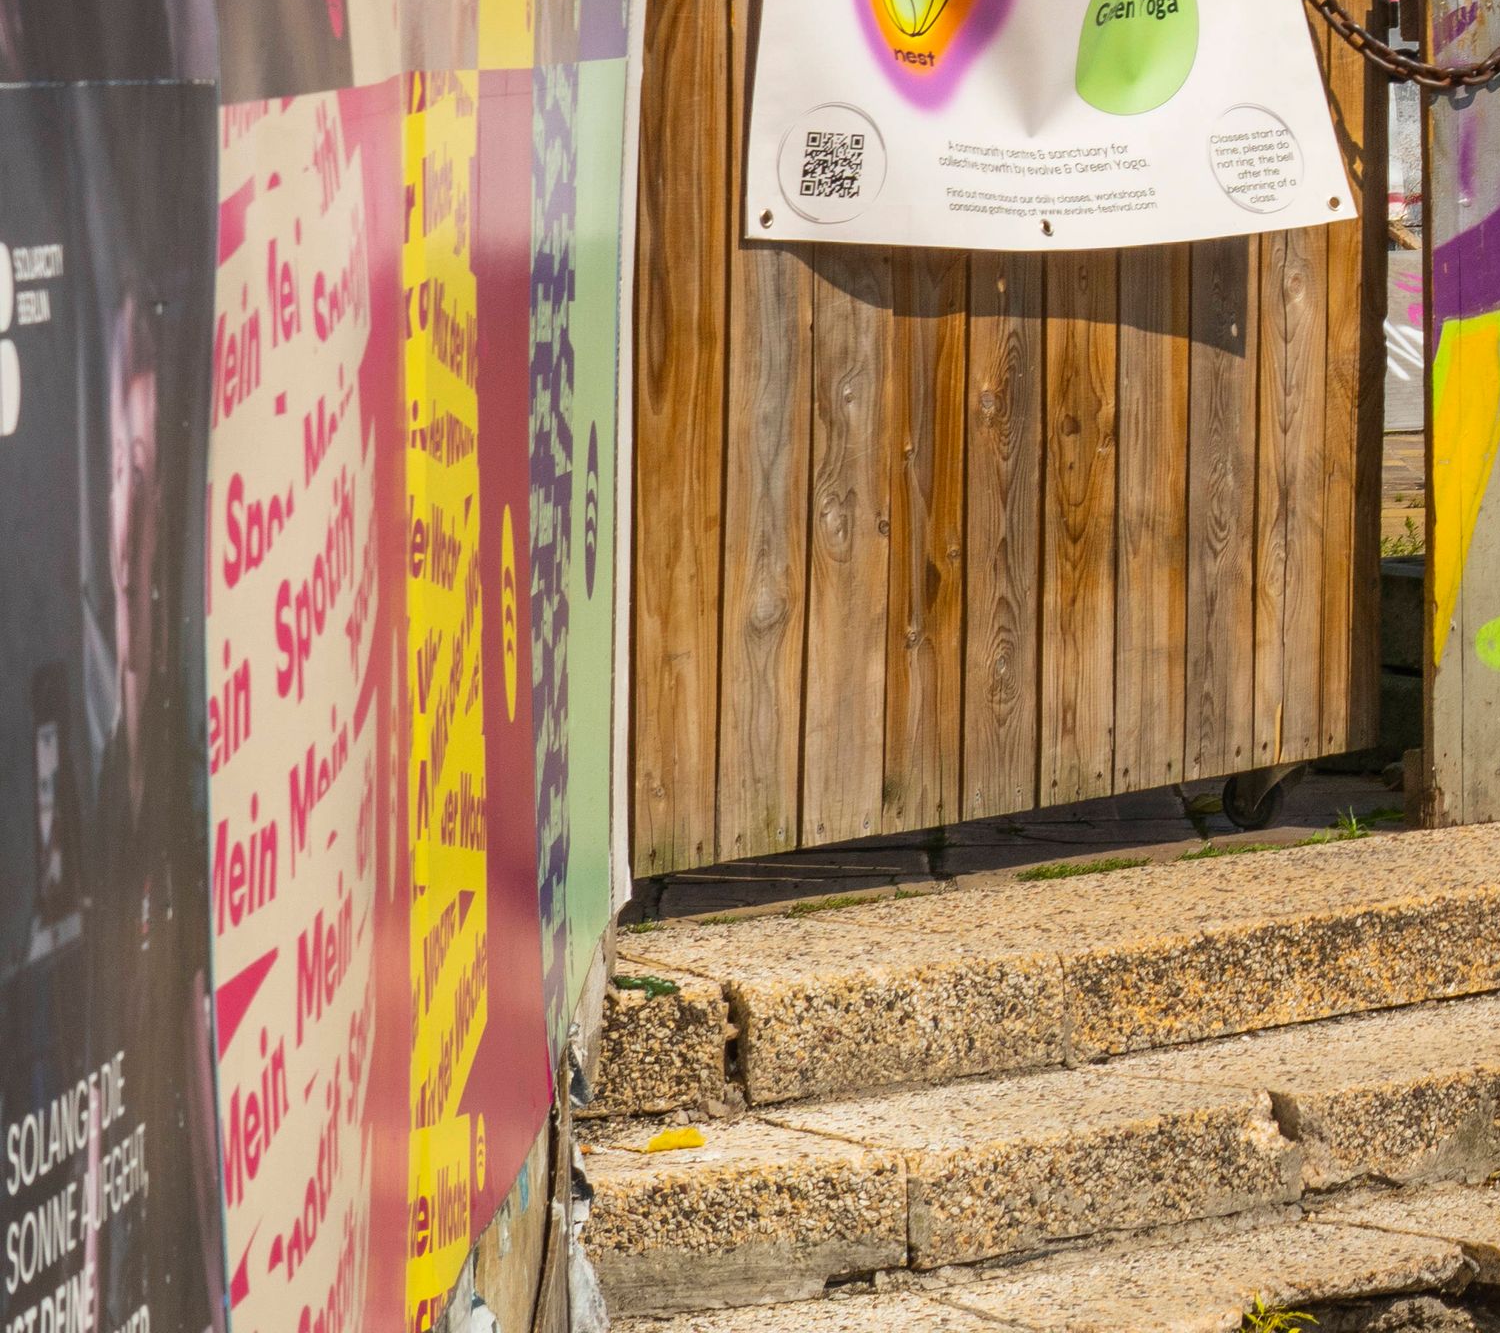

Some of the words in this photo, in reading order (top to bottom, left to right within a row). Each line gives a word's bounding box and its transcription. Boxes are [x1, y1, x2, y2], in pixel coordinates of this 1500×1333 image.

[892, 45, 935, 67] nest
[1210, 132, 1250, 144] Classes
[1251, 130, 1273, 140] start
[1243, 143, 1274, 155] please
[1277, 141, 1289, 149] do
[1217, 159, 1234, 168] not
[1259, 156, 1274, 164] the
[1276, 152, 1294, 162] bell
[1238, 170, 1261, 179] after
[1264, 167, 1280, 175] the
[1227, 180, 1276, 193] beginning
[1277, 178, 1287, 188] of
[100, 1050, 125, 1131] DIE
[6, 1183, 77, 1295] SONNE
